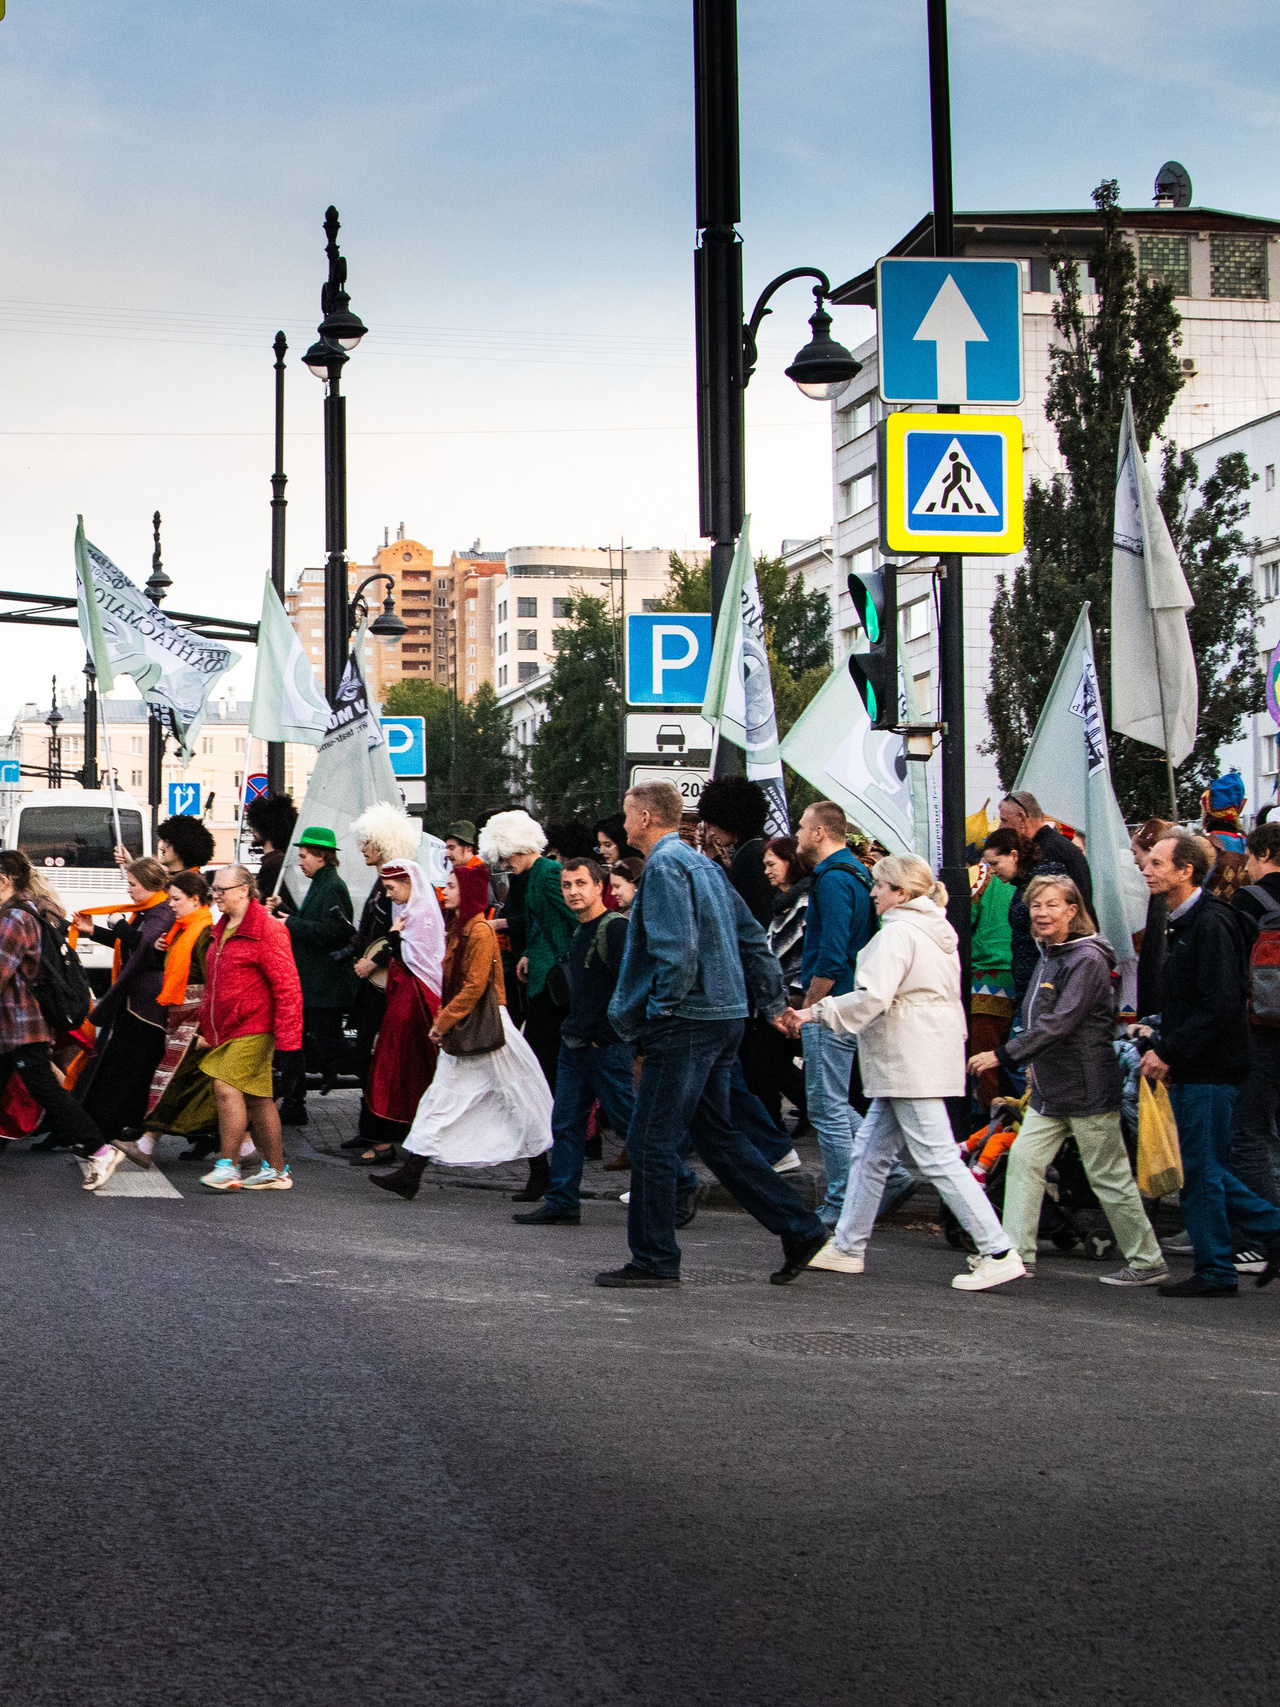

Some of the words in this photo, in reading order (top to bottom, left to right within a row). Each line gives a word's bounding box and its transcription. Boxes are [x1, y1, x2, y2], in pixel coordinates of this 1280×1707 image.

[652, 624, 699, 694] P
[382, 723, 415, 753] P
[680, 782, 700, 798] 20
